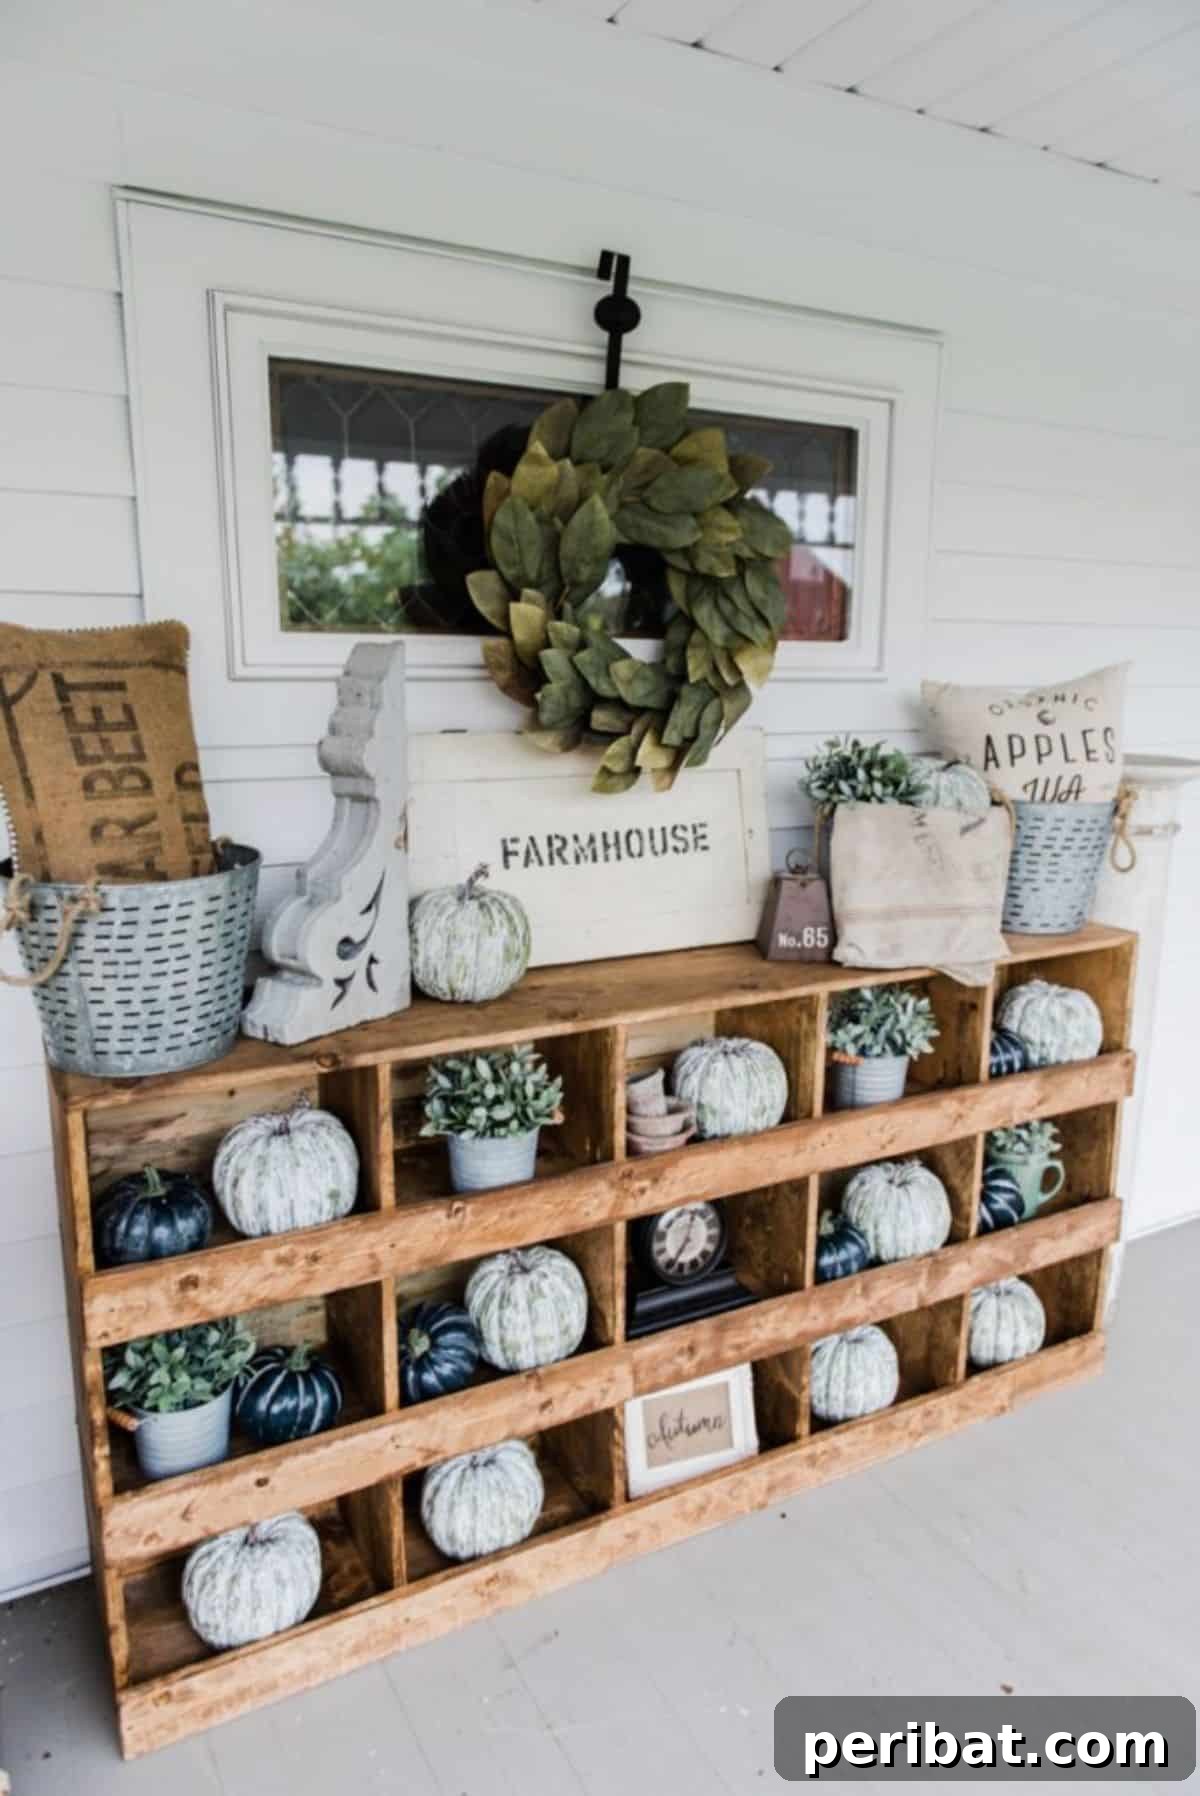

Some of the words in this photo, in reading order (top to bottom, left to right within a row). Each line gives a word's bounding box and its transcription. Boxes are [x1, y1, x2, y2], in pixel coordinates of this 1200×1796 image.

[51, 671, 154, 801] BEET
[983, 726, 1117, 772] APPLES
[500, 821, 711, 870] FARMHOUSE
